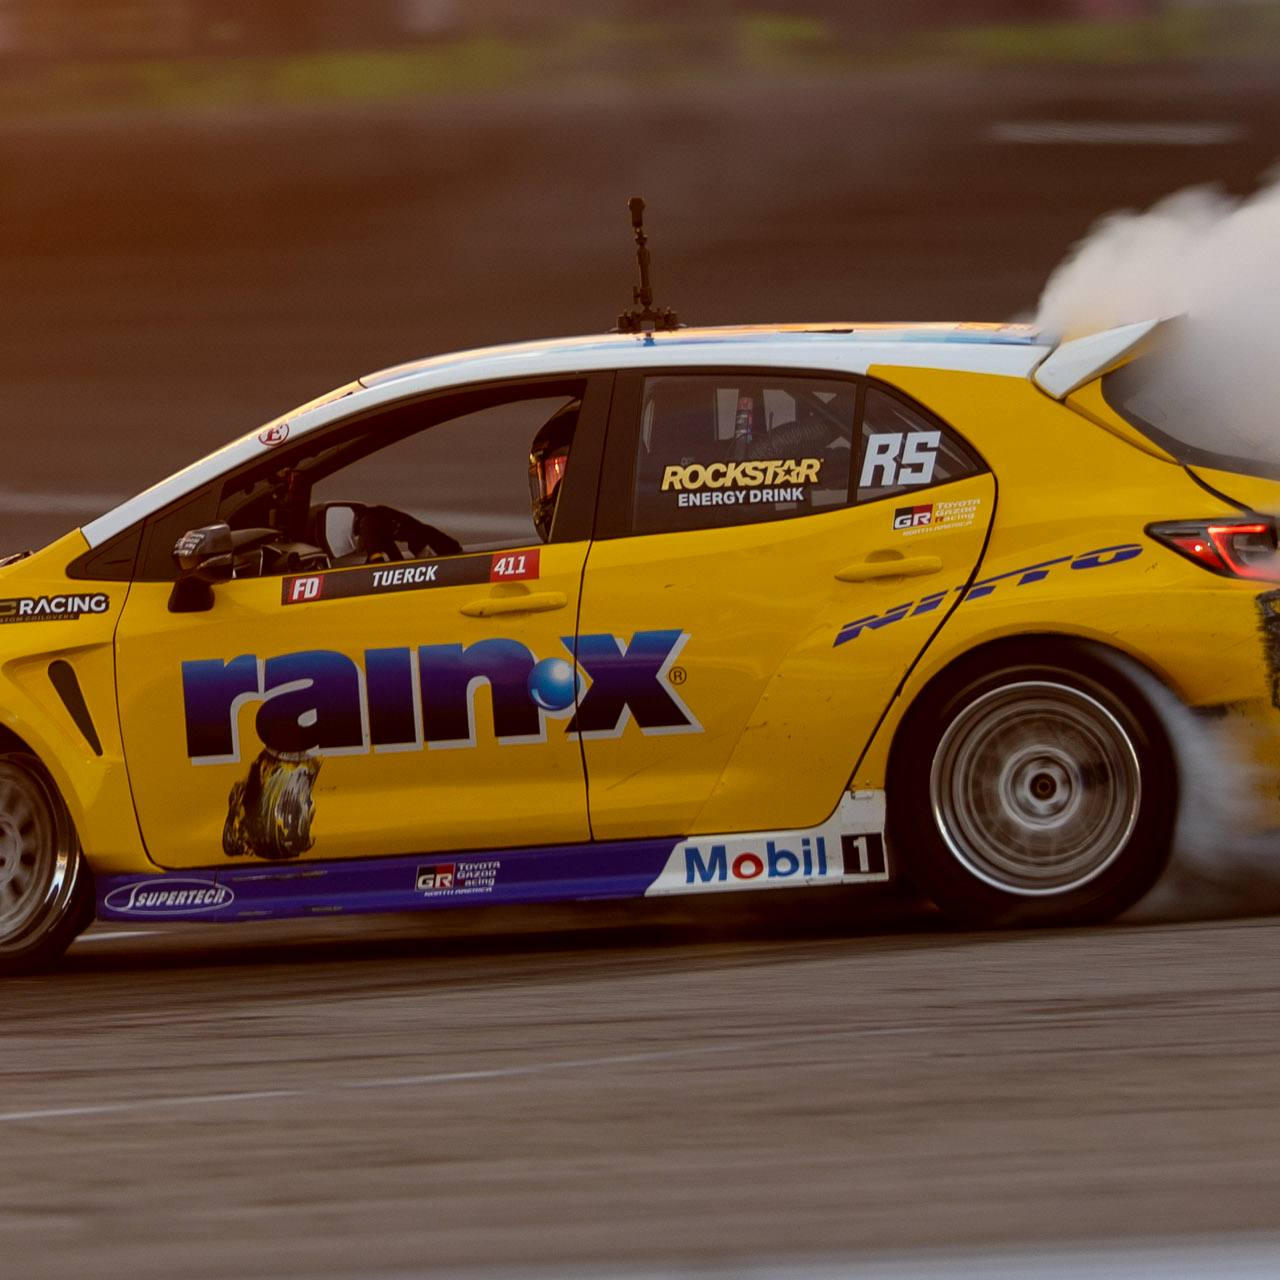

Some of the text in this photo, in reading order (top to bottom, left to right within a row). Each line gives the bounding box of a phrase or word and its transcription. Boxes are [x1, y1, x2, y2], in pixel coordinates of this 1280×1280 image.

[859, 431, 941, 487] RS
[660, 458, 821, 491] ROCKSTAR
[678, 487, 804, 507] ENERGY DRINK
[937, 498, 980, 509] TOYOTA
[894, 512, 931, 529] GR
[935, 506, 976, 517] GAZOO
[292, 556, 526, 600] FD TUERCK 411
[833, 543, 1143, 647] NITTO
[458, 861, 500, 871] TOYOTA
[684, 836, 827, 883] Mobil
[417, 873, 453, 889] GR
[457, 869, 496, 879] GAZOO
[135, 888, 226, 907] SUPERTECH
